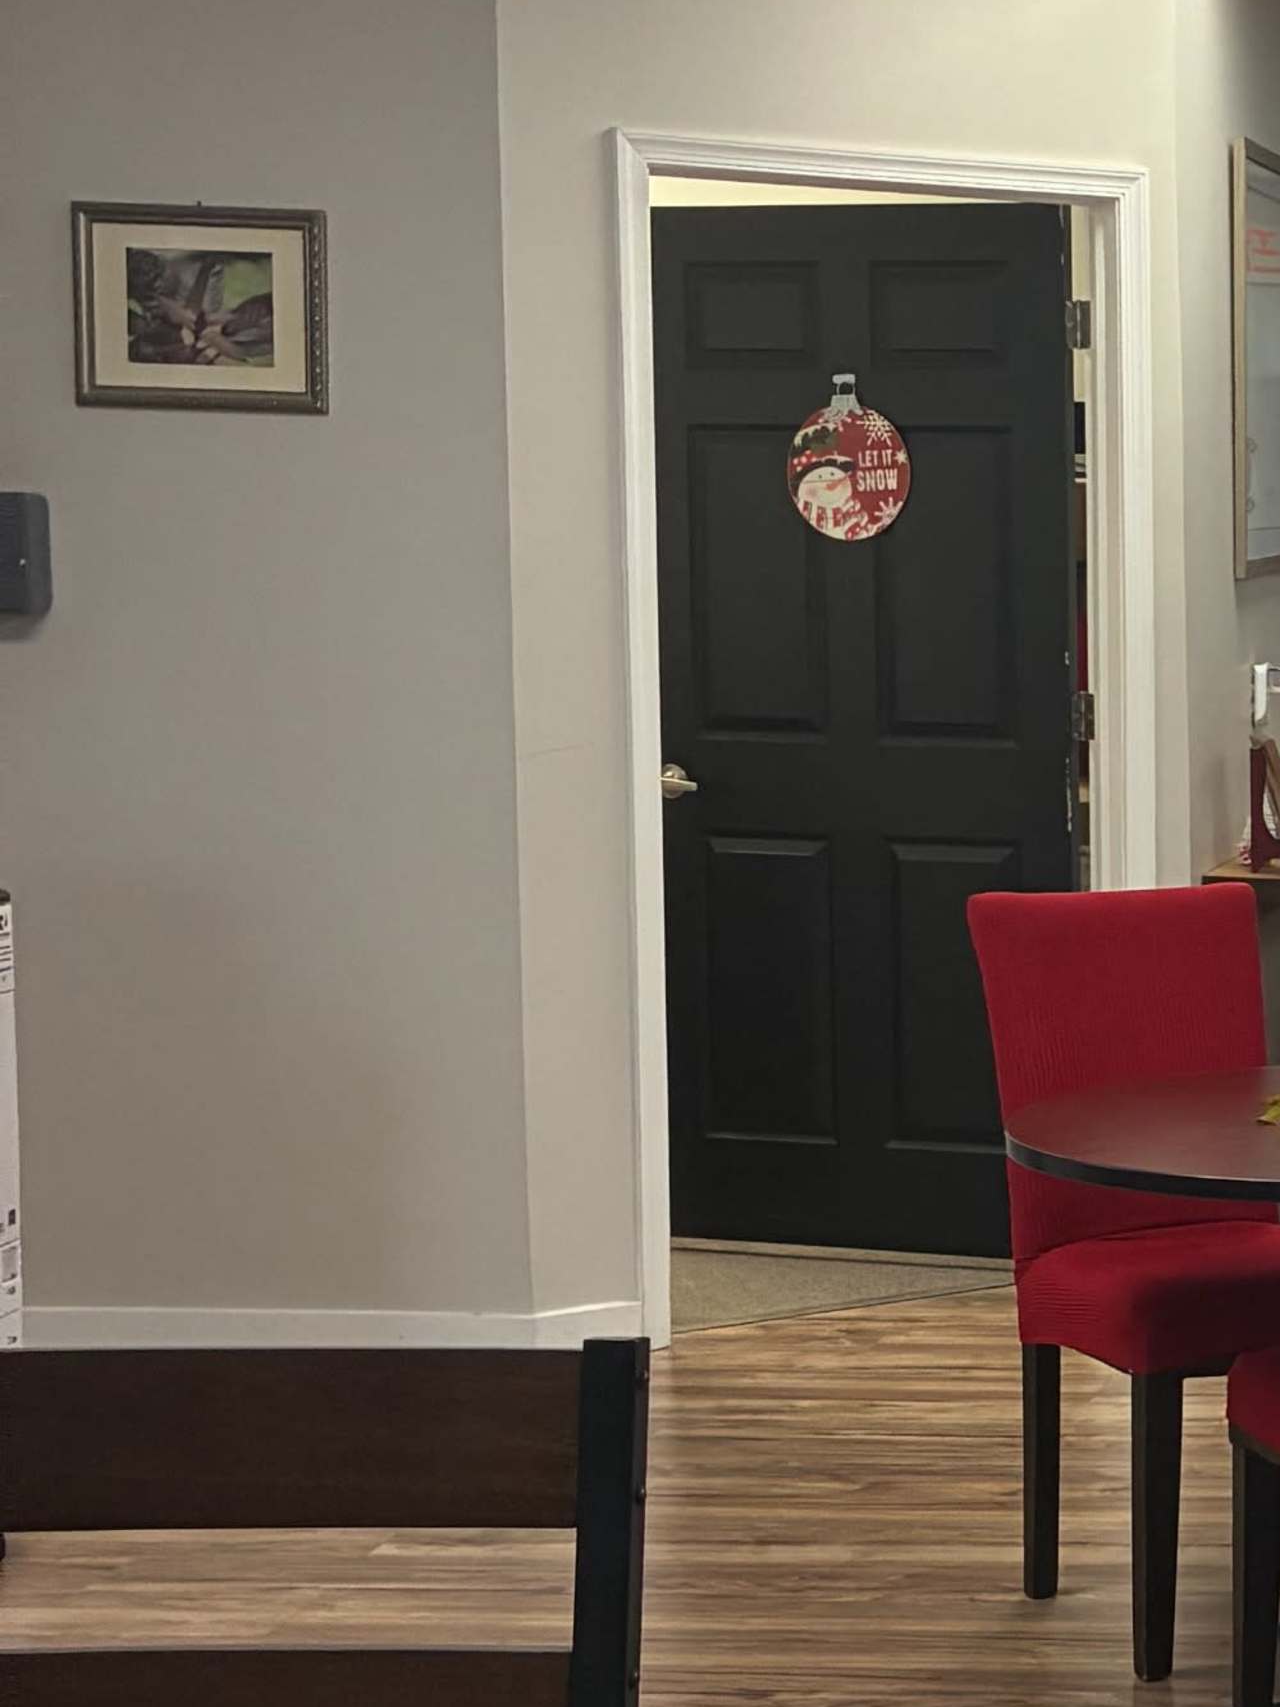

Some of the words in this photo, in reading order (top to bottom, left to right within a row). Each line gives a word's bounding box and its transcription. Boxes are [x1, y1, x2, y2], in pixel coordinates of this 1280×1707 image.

[858, 450, 878, 467] LET
[881, 449, 893, 467] IT
[857, 468, 898, 491] SNOW
